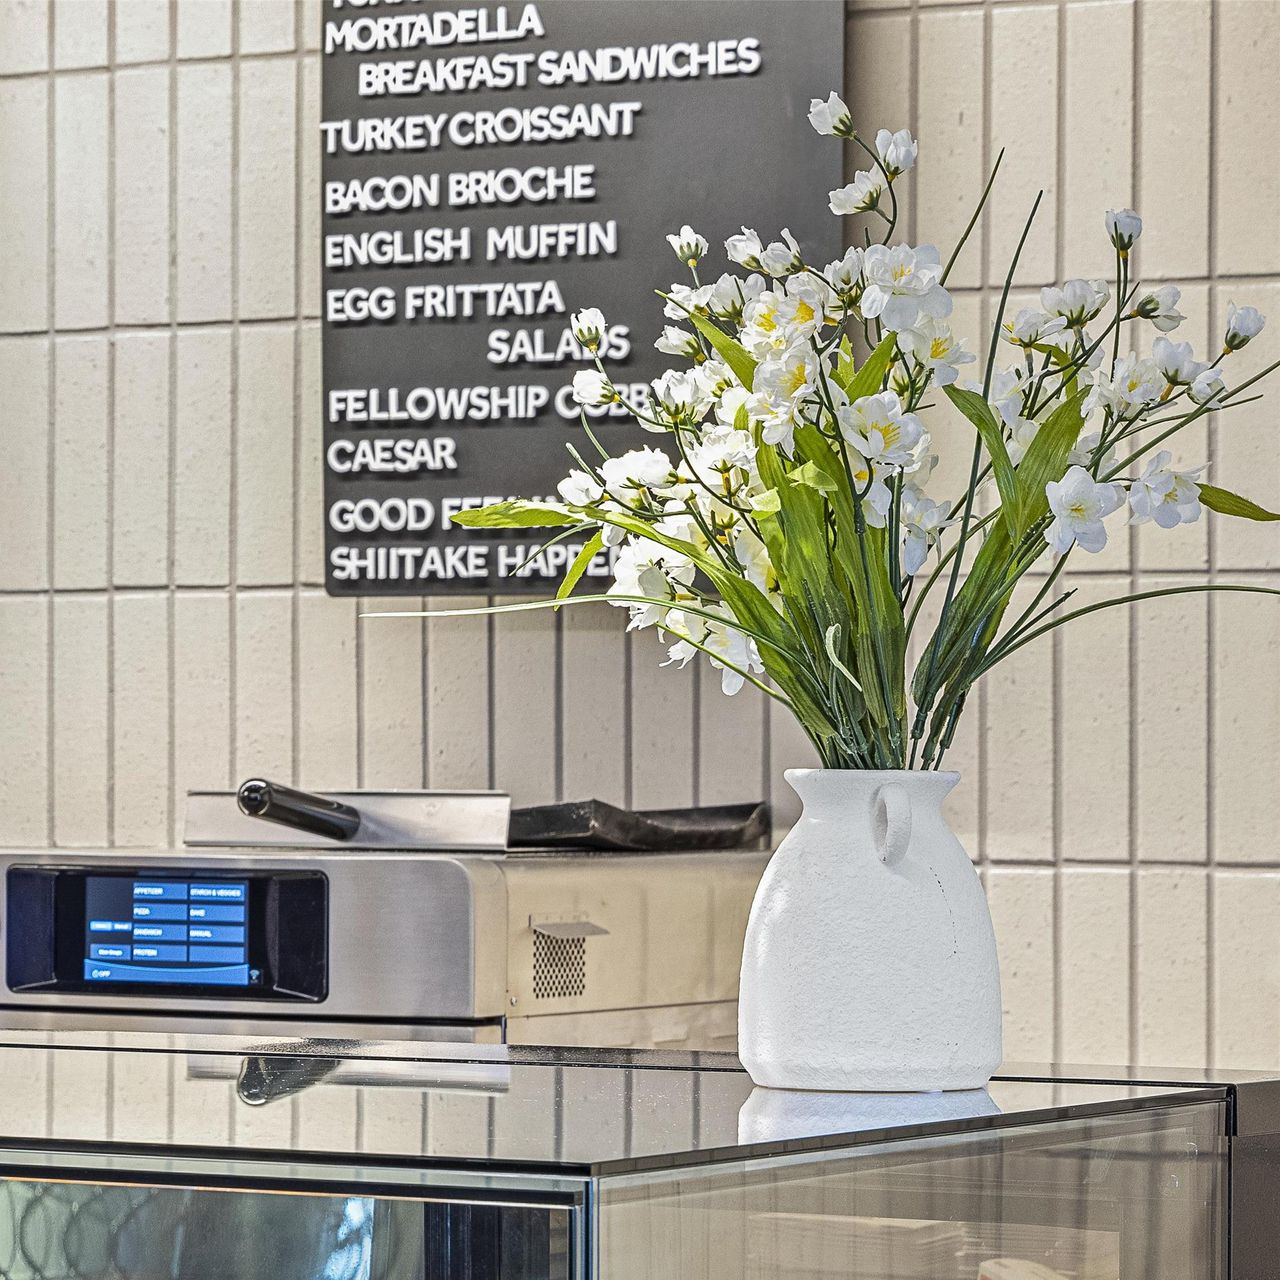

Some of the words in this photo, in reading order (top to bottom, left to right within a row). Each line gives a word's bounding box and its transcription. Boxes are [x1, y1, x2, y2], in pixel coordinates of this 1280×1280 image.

[324, 5, 544, 54] MORTADELLA
[358, 52, 536, 96] BREAKFAST
[536, 37, 761, 85] SANDWICHES
[320, 111, 448, 155] TURKEY
[447, 101, 642, 146] CROISSANT
[325, 173, 440, 214] BACON
[447, 163, 596, 206] BRIOCHE
[325, 227, 471, 268] ENGLISH
[485, 220, 618, 262] MUFFIN
[325, 285, 395, 323] EGG
[404, 279, 565, 320] FRITTATA
[328, 384, 550, 424] FELLOWSHIP
[326, 437, 458, 474] CAESAR
[330, 497, 435, 534] GOOD
[330, 545, 489, 582] SHIITAKE
